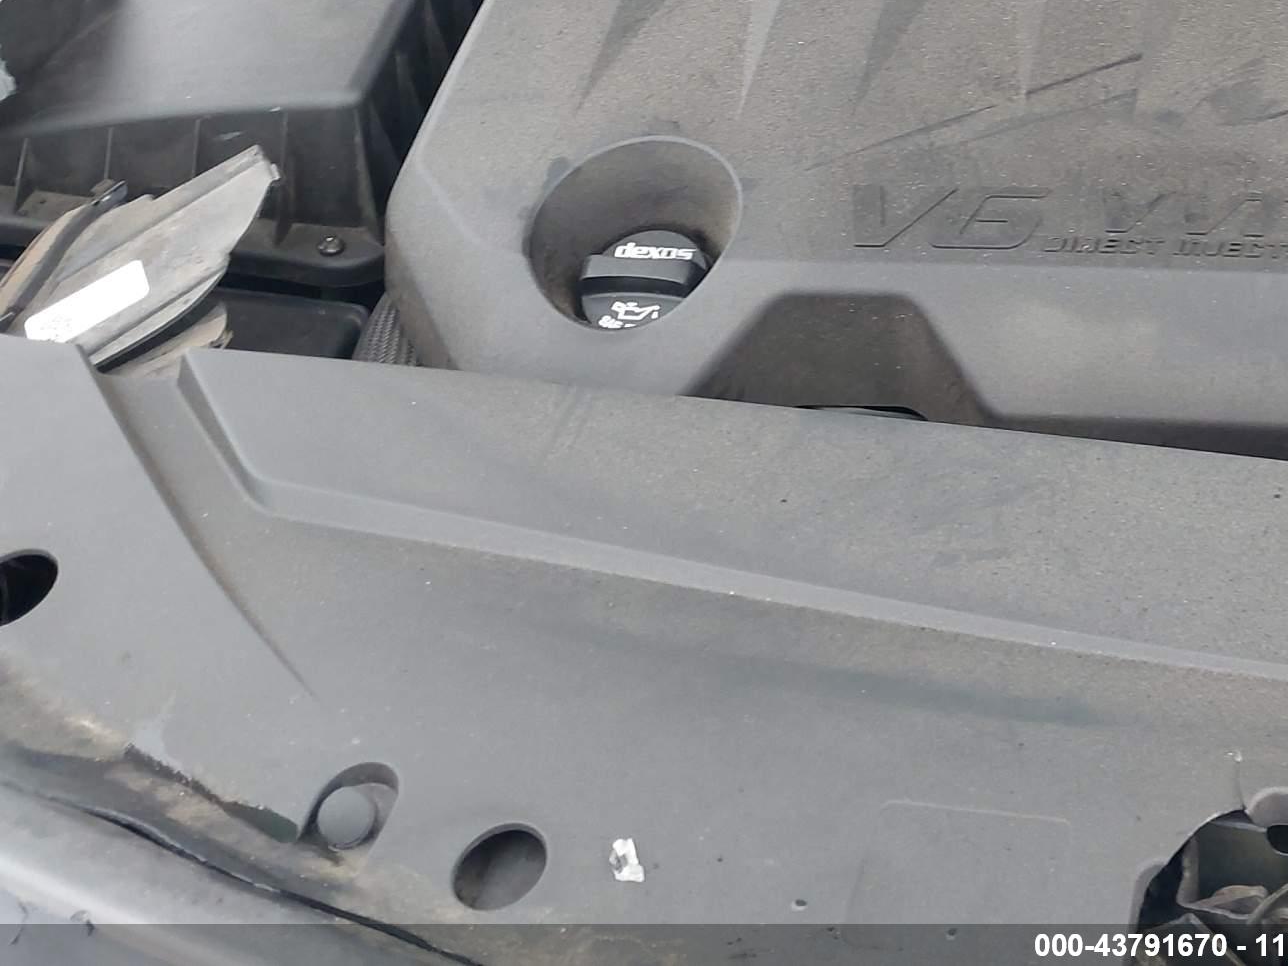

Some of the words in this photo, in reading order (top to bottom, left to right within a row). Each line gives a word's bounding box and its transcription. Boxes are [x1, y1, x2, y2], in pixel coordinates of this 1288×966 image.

[852, 184, 1053, 250] V6
[614, 241, 698, 261] dexos
[1042, 235, 1167, 255] DIRECT
